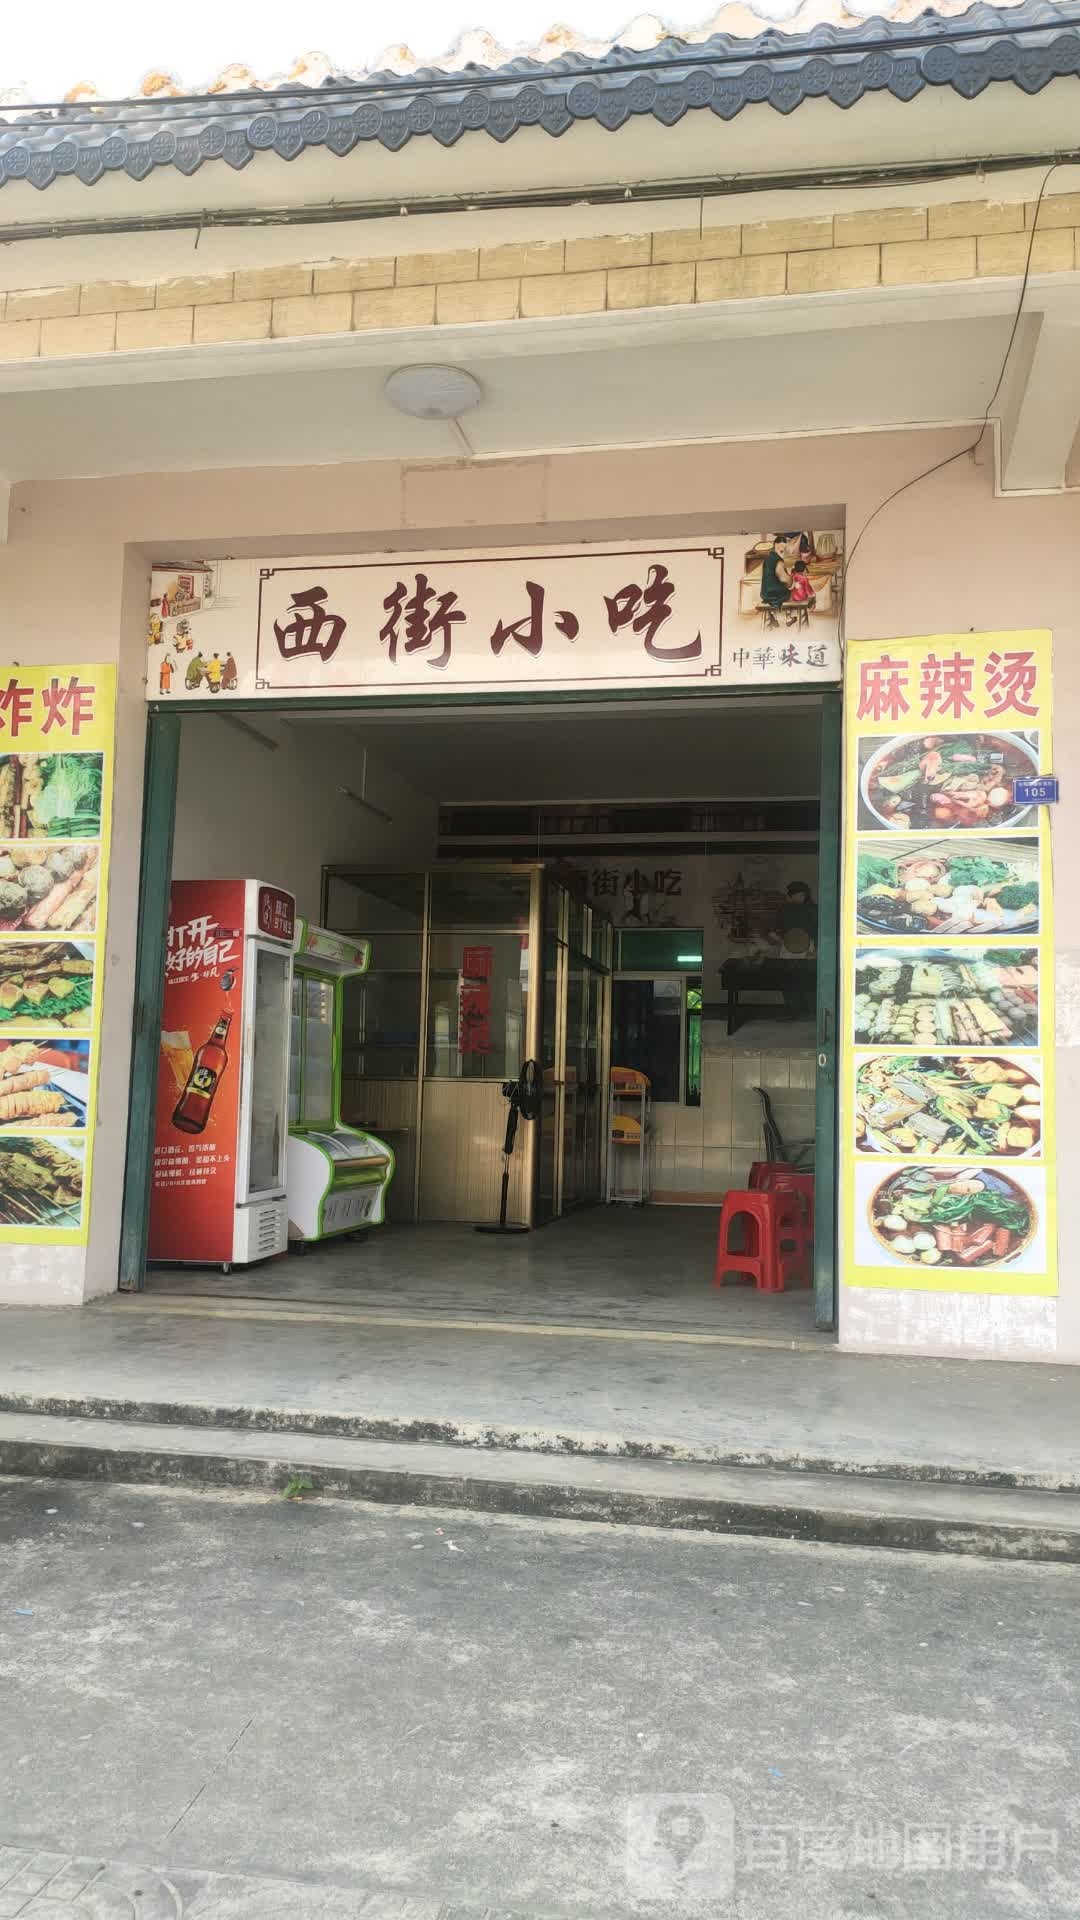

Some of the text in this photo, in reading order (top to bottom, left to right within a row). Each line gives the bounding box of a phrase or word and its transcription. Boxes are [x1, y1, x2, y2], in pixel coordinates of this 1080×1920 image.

[272, 564, 703, 669] 西街小吃
[733, 643, 829, 671] 中華味道
[856, 651, 1040, 722] 麻辣烫
[1024, 787, 1046, 798] 105
[167, 914, 221, 949] 打开
